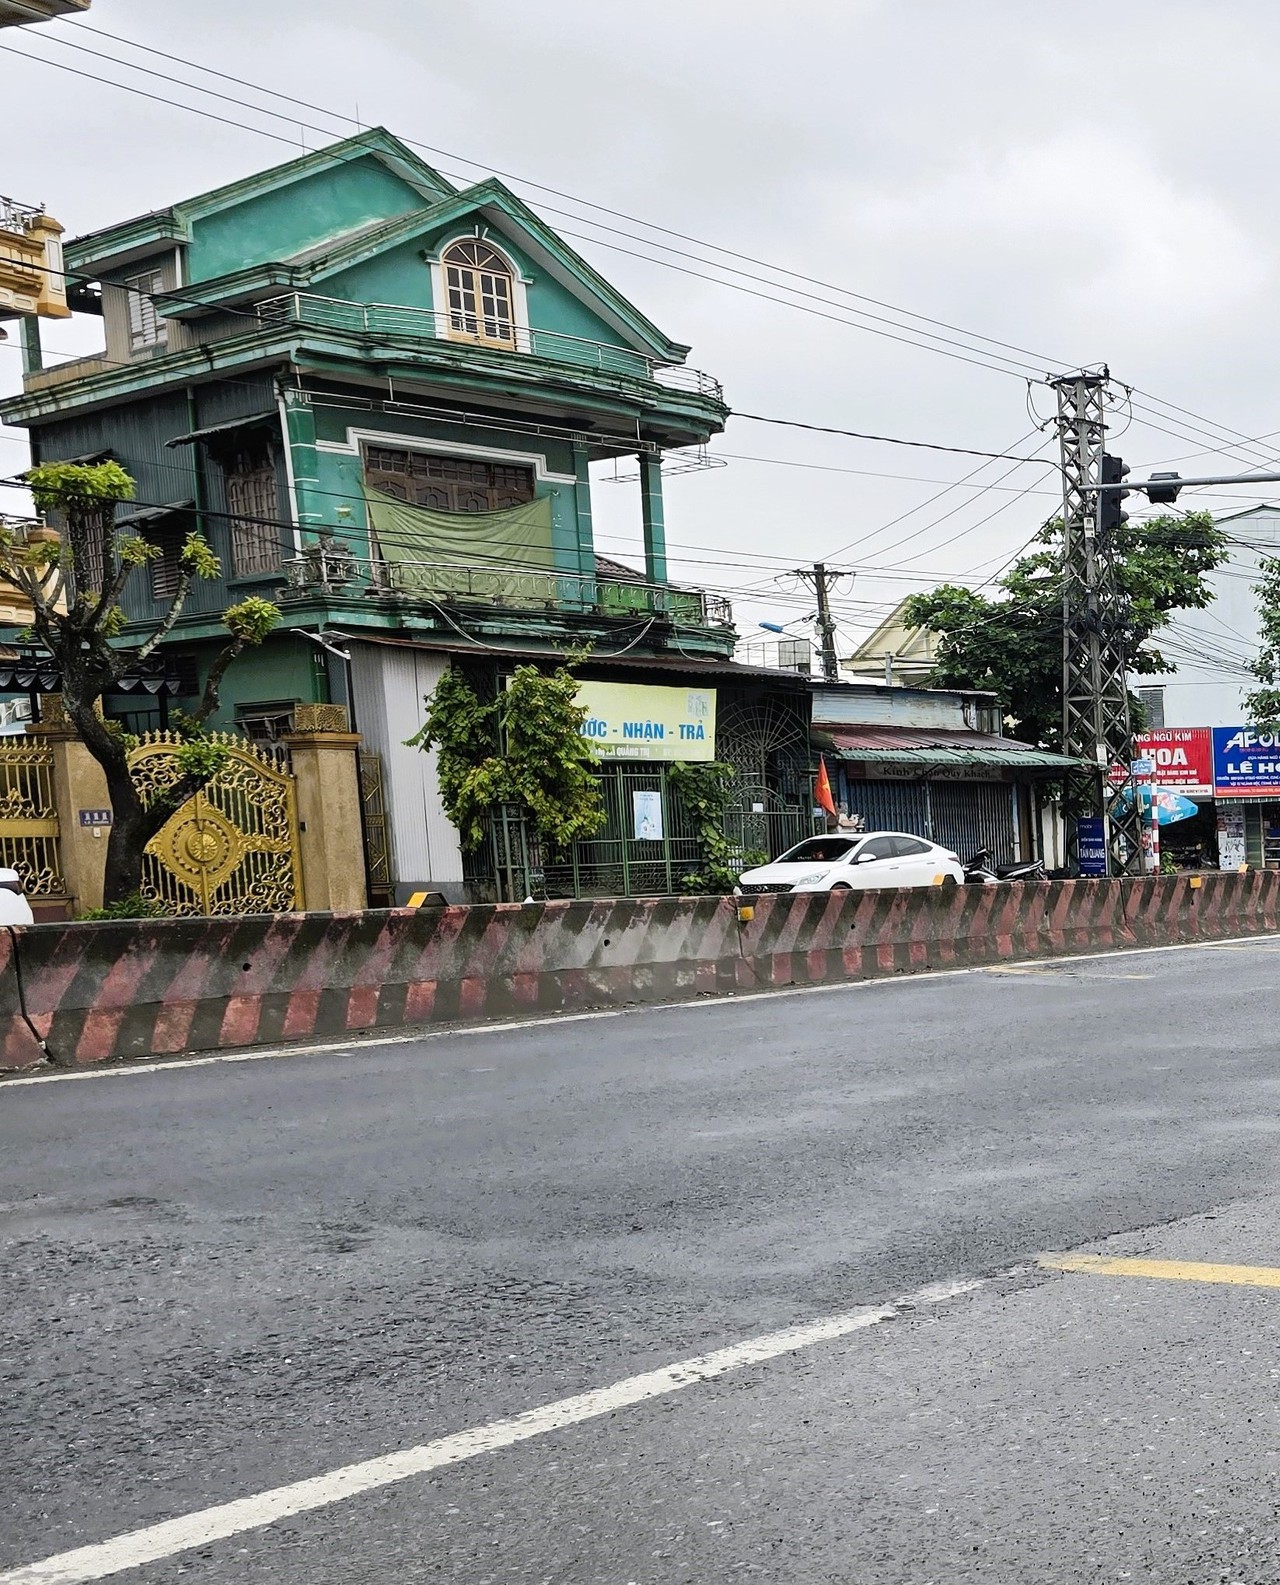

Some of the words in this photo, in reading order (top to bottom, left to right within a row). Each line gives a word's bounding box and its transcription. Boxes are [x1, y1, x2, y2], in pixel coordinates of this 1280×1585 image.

[622, 720, 664, 742] NHẬN
[679, 720, 705, 740] TRẢ
[1154, 732, 1172, 742] NGŨ
[1175, 732, 1192, 742] KIM
[616, 745, 638, 757] QUẢNG
[1141, 748, 1188, 766] HOA
[1227, 760, 1254, 774] LÊ
